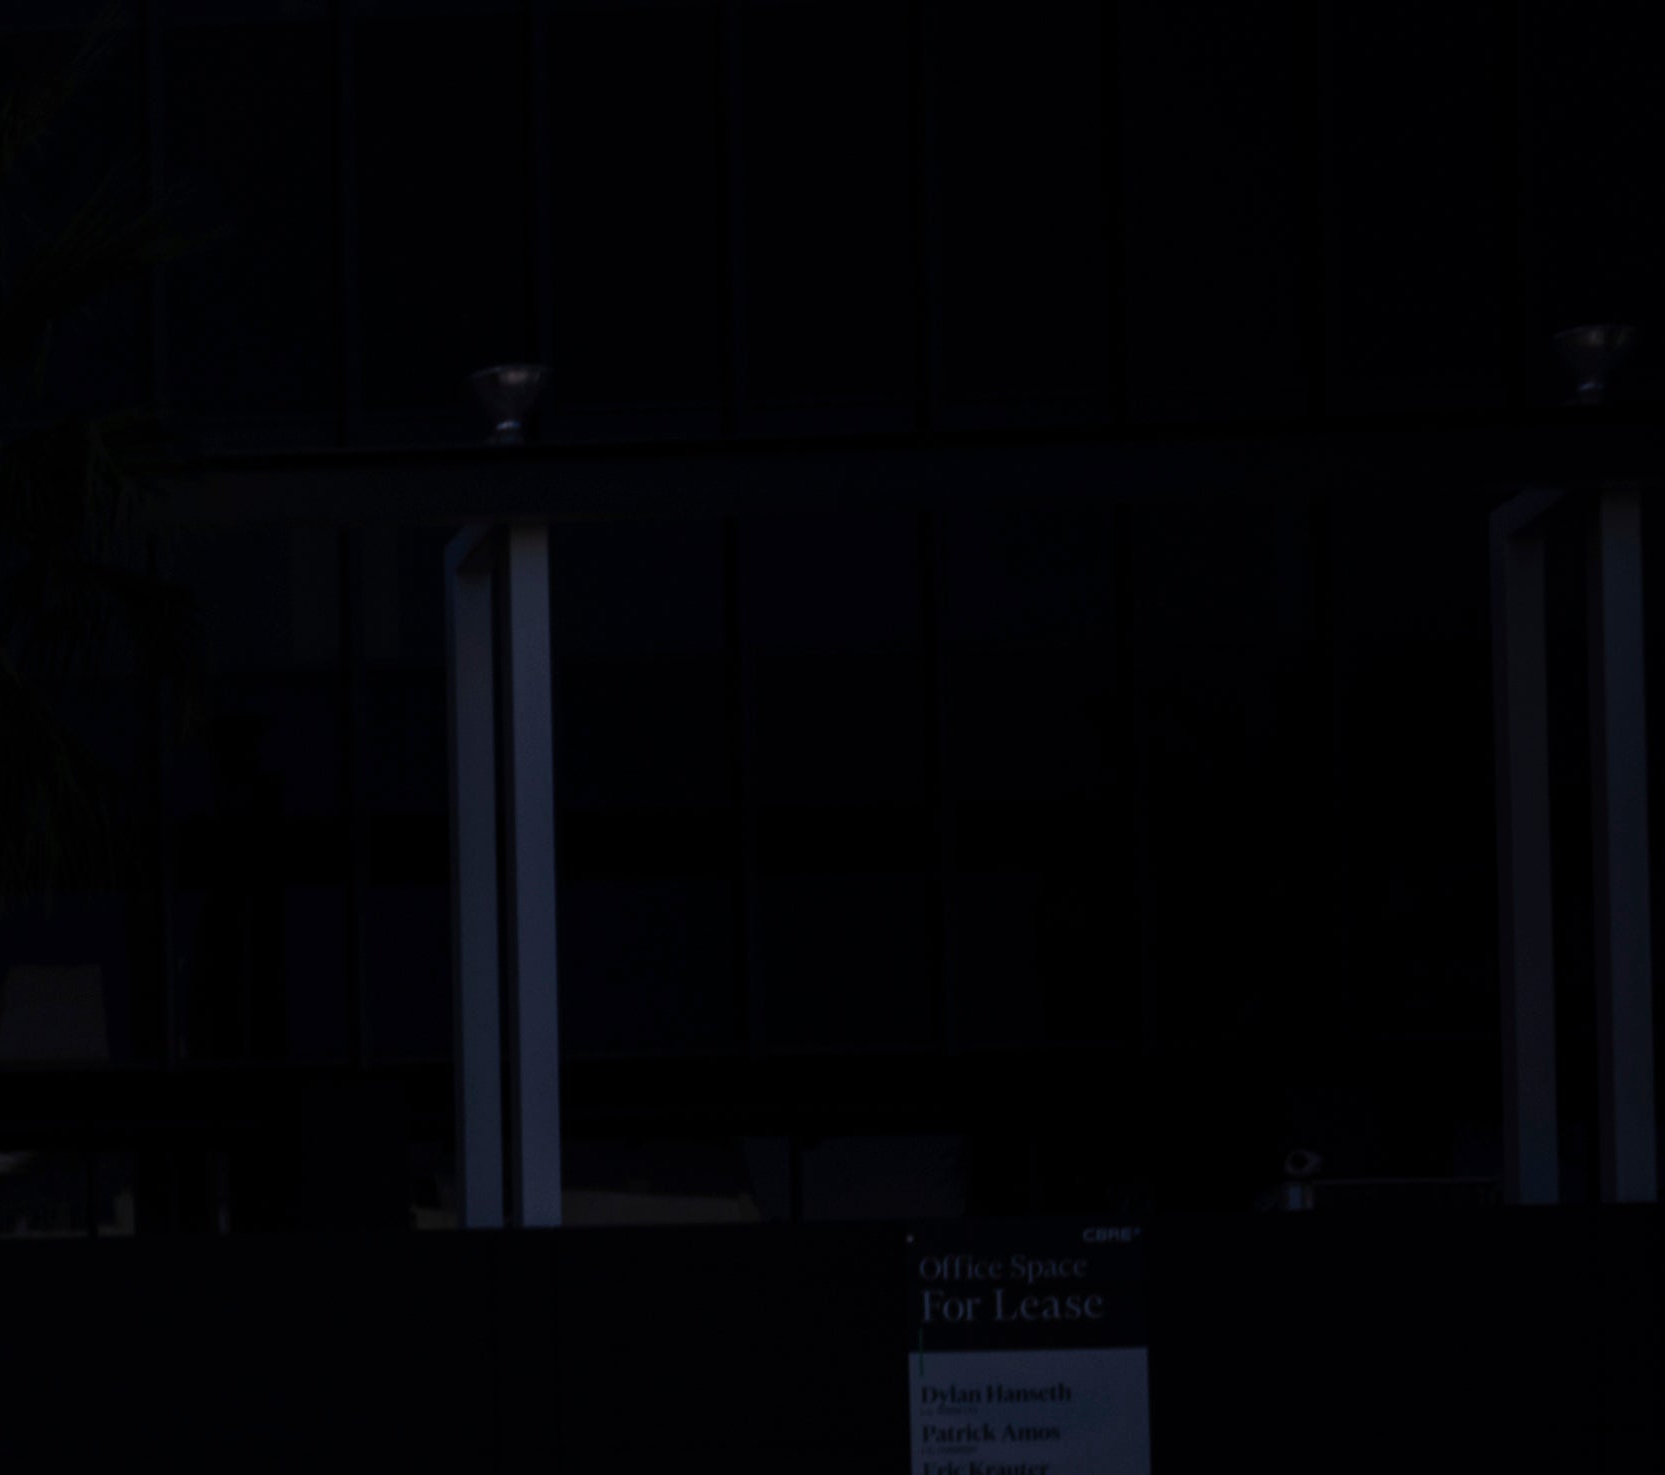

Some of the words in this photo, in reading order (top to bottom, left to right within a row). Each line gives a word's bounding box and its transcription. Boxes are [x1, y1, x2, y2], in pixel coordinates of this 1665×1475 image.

[919, 1255, 1004, 1281] Office
[1008, 1252, 1089, 1286] Space
[920, 1287, 982, 1323] For
[991, 1286, 1107, 1321] Lease
[920, 1385, 982, 1410] Dylan
[986, 1382, 1073, 1404] Hanseth
[921, 1423, 996, 1444] Patrick
[1002, 1424, 1062, 1443] Amos
